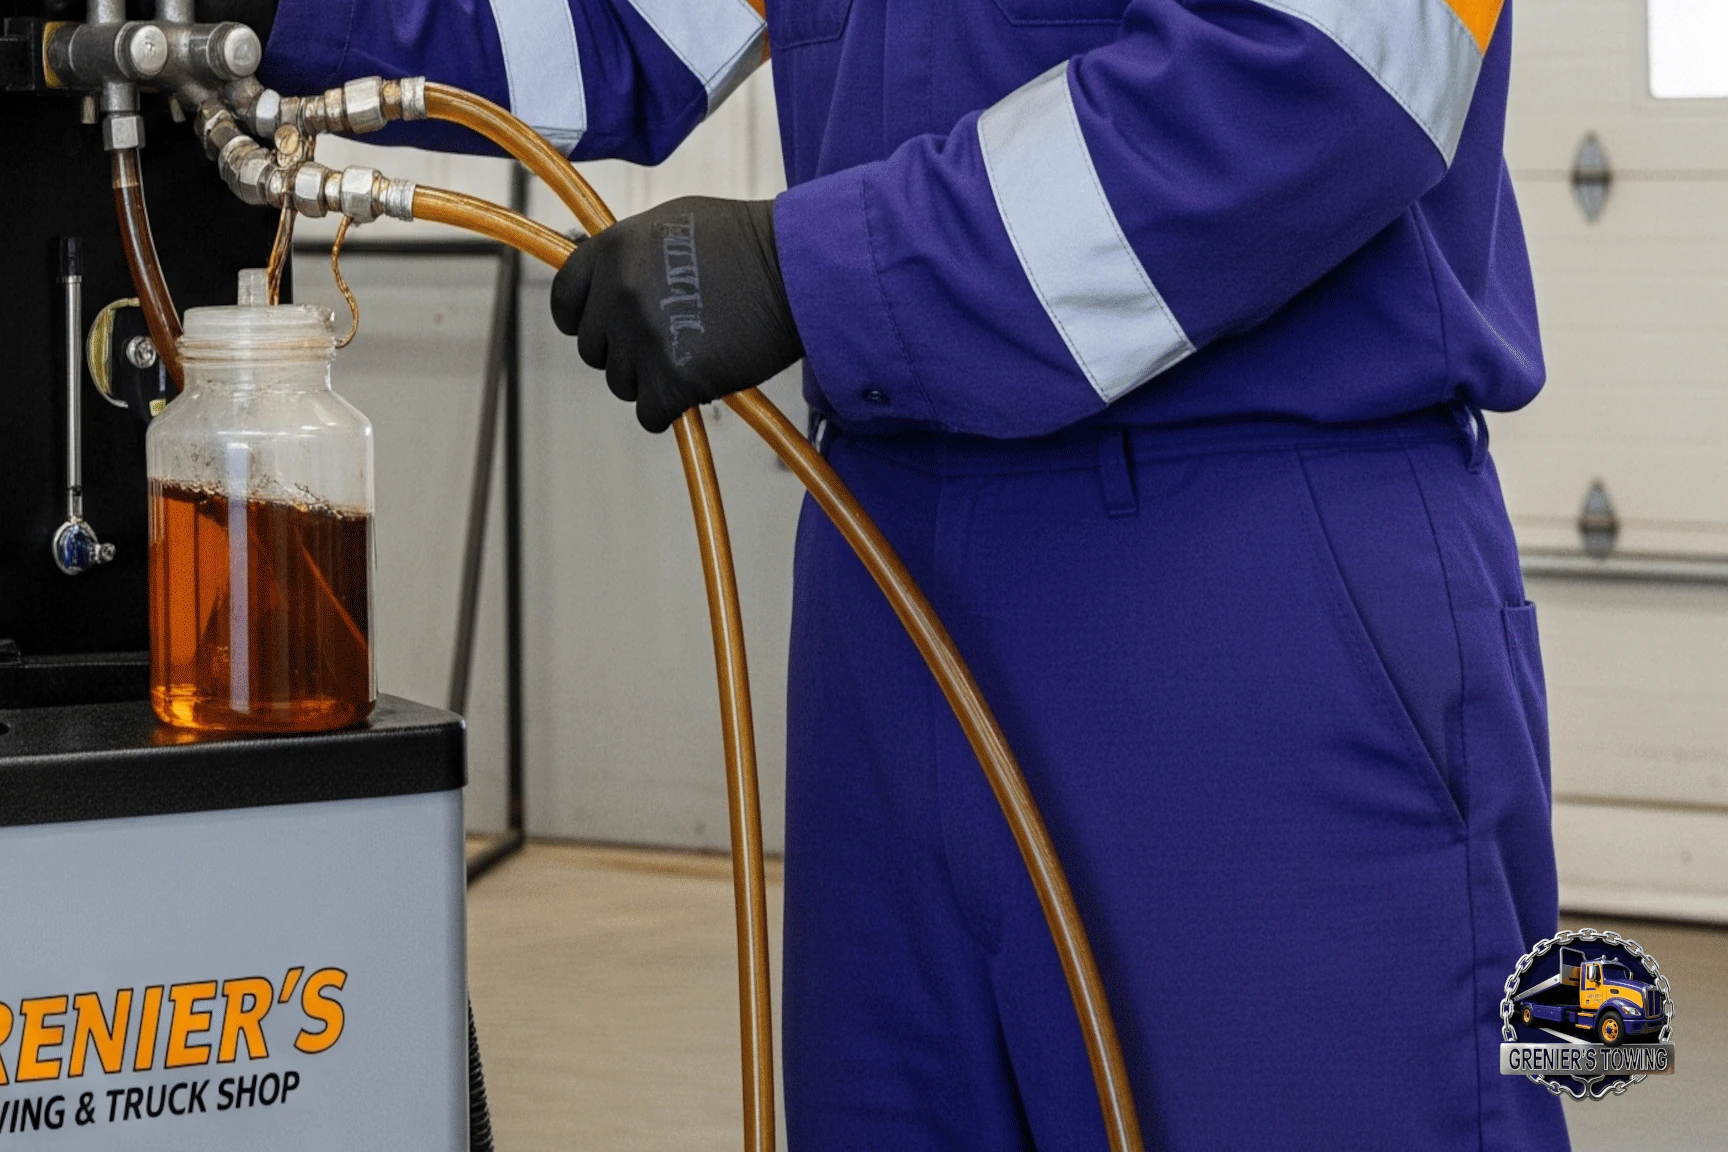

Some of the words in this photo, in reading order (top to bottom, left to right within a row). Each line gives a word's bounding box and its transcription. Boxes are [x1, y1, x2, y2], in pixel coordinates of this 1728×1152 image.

[74, 1091, 96, 1126] &
[105, 1079, 209, 1123] TRUCK
[216, 1070, 301, 1111] SHOP
